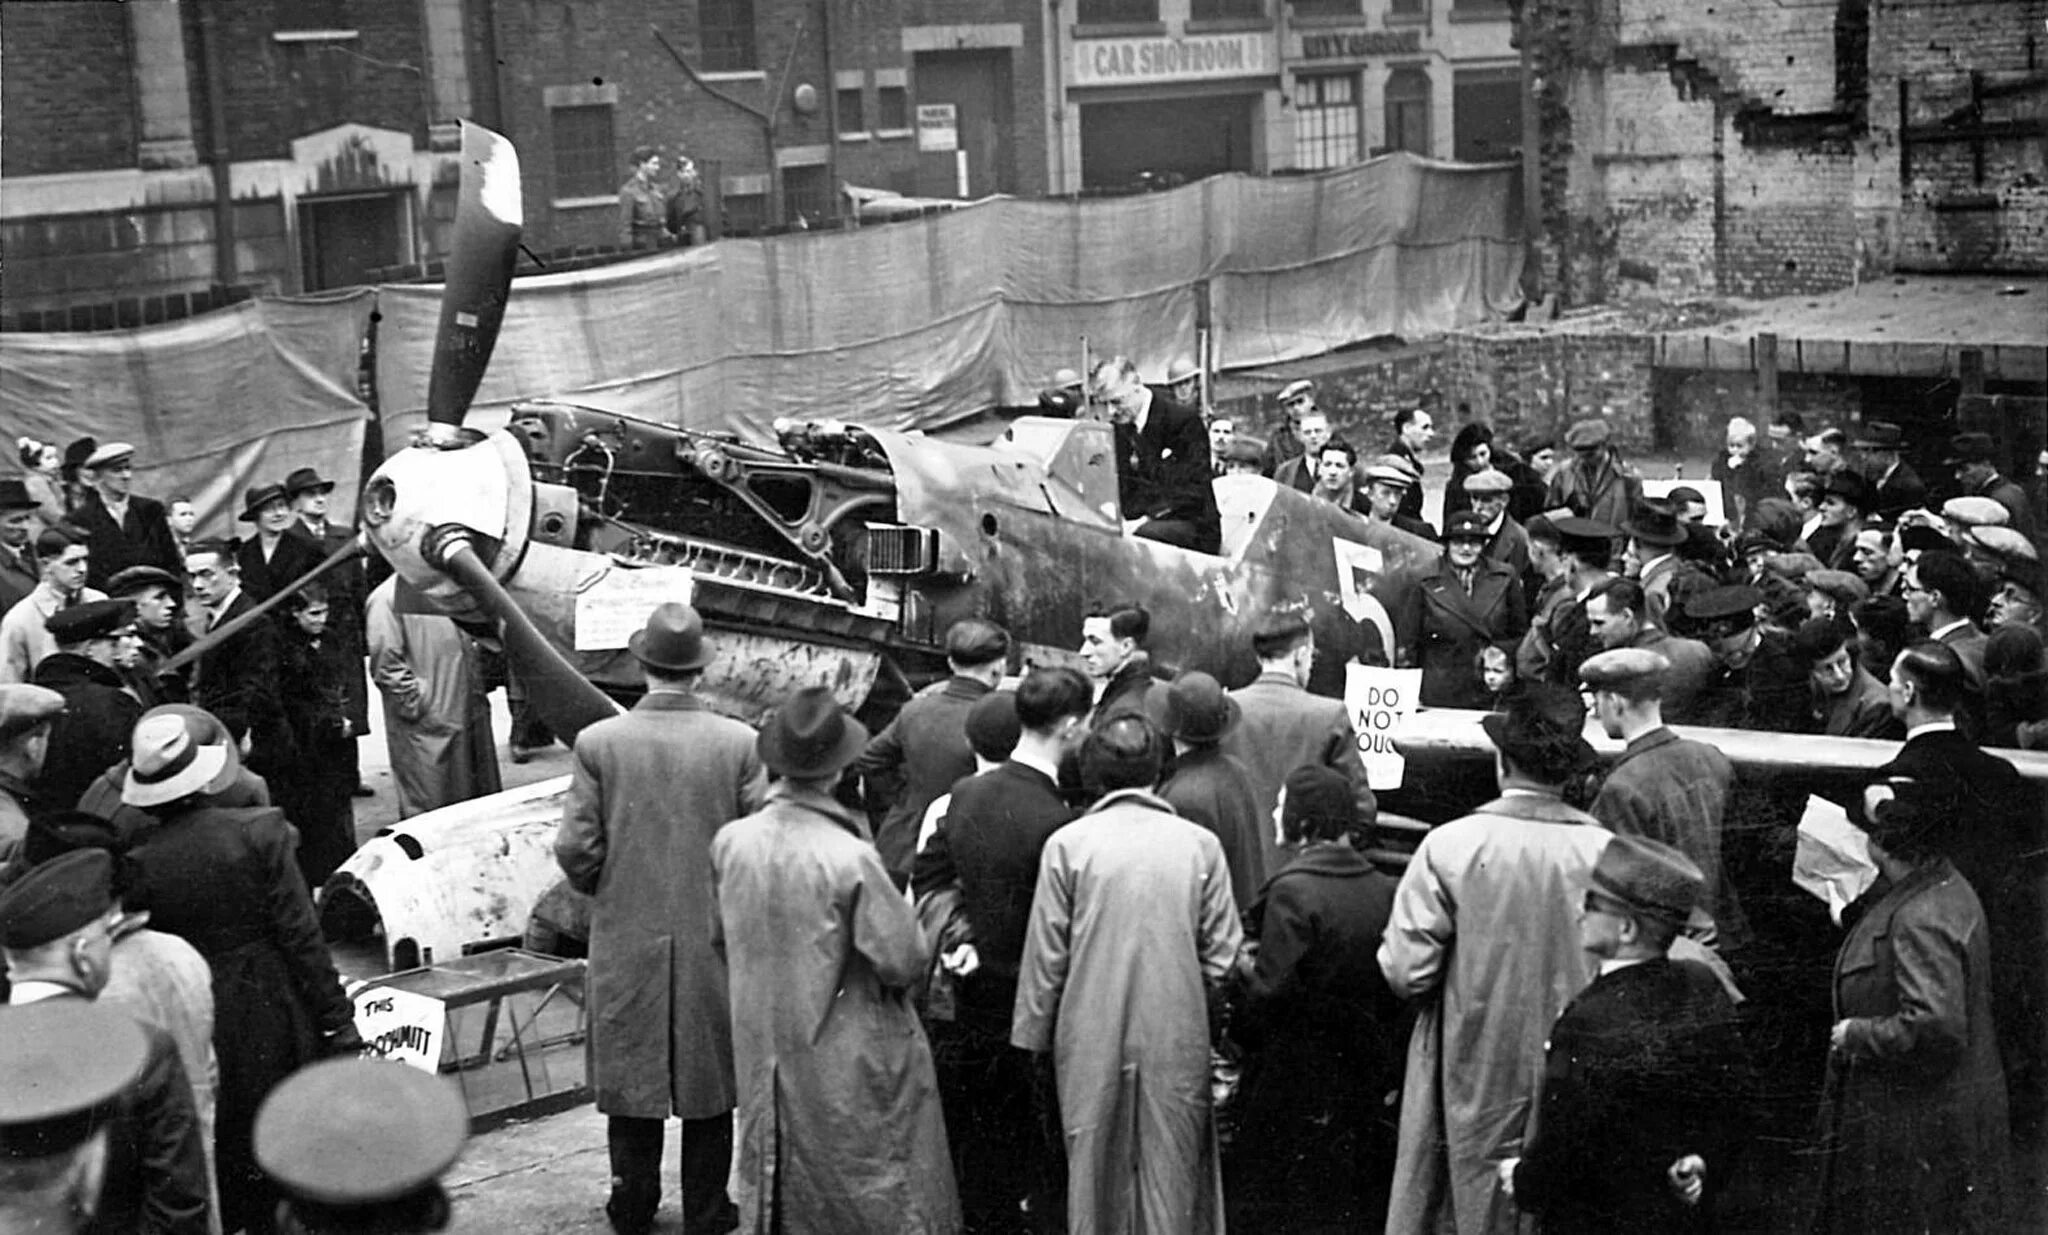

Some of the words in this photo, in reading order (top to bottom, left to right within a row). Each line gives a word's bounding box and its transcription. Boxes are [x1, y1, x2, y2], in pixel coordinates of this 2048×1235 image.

[1096, 44, 1135, 76] CAR
[1139, 39, 1243, 75] SHOWROOM
[1368, 686, 1400, 708] DO
[1358, 709, 1403, 730] NOT
[1356, 732, 1394, 754] OUC
[363, 997, 395, 1017] THIS
